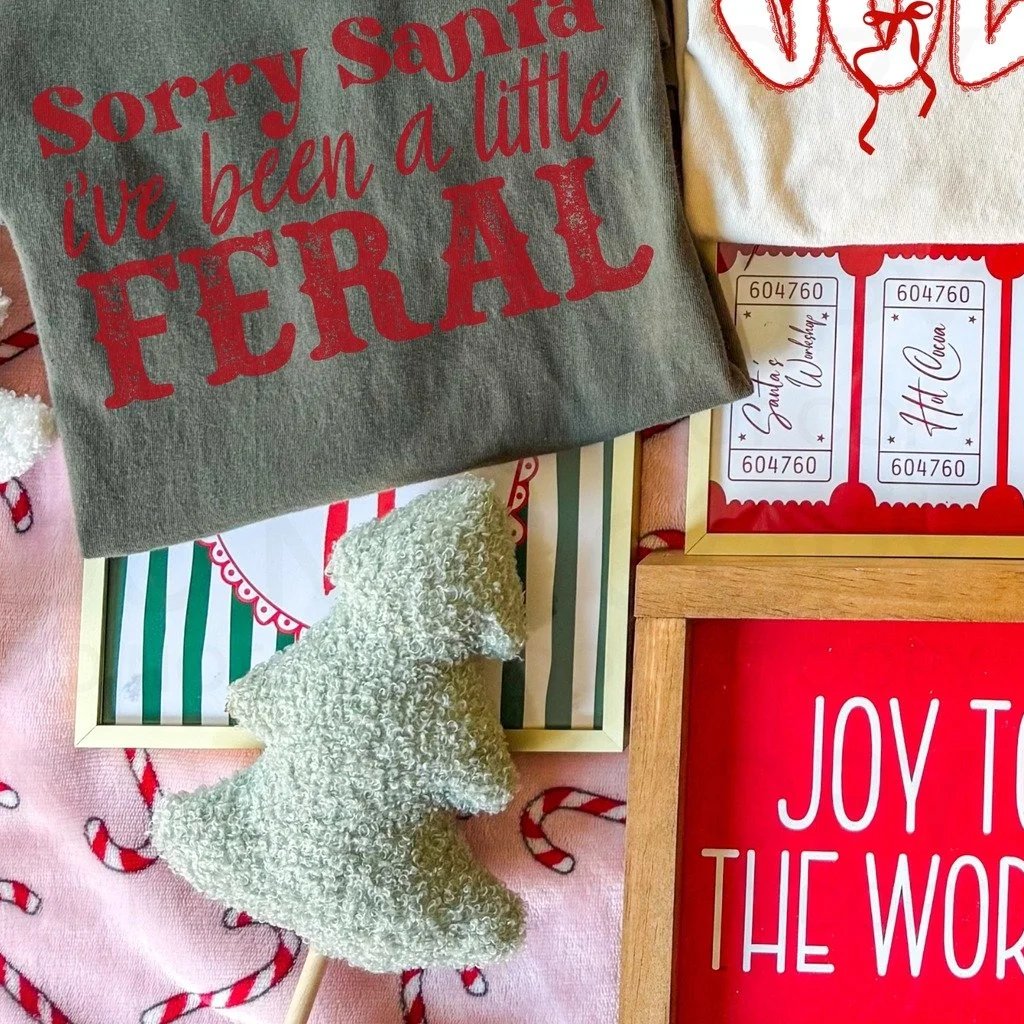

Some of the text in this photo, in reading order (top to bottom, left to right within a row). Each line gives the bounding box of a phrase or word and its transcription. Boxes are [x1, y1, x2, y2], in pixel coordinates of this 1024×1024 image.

[32, 48, 308, 160] Sorry
[63, 51, 623, 260] i've been a little
[76, 157, 654, 410] FERAL
[750, 281, 823, 300] 604760
[896, 284, 970, 304] 604760
[741, 357, 793, 435] Santa's
[784, 314, 828, 388] Workshop
[899, 322, 964, 437] Hot Cocoa
[742, 454, 817, 475] 604760
[891, 457, 966, 477] 604760
[777, 695, 940, 834] JOY
[701, 848, 839, 973] THE
